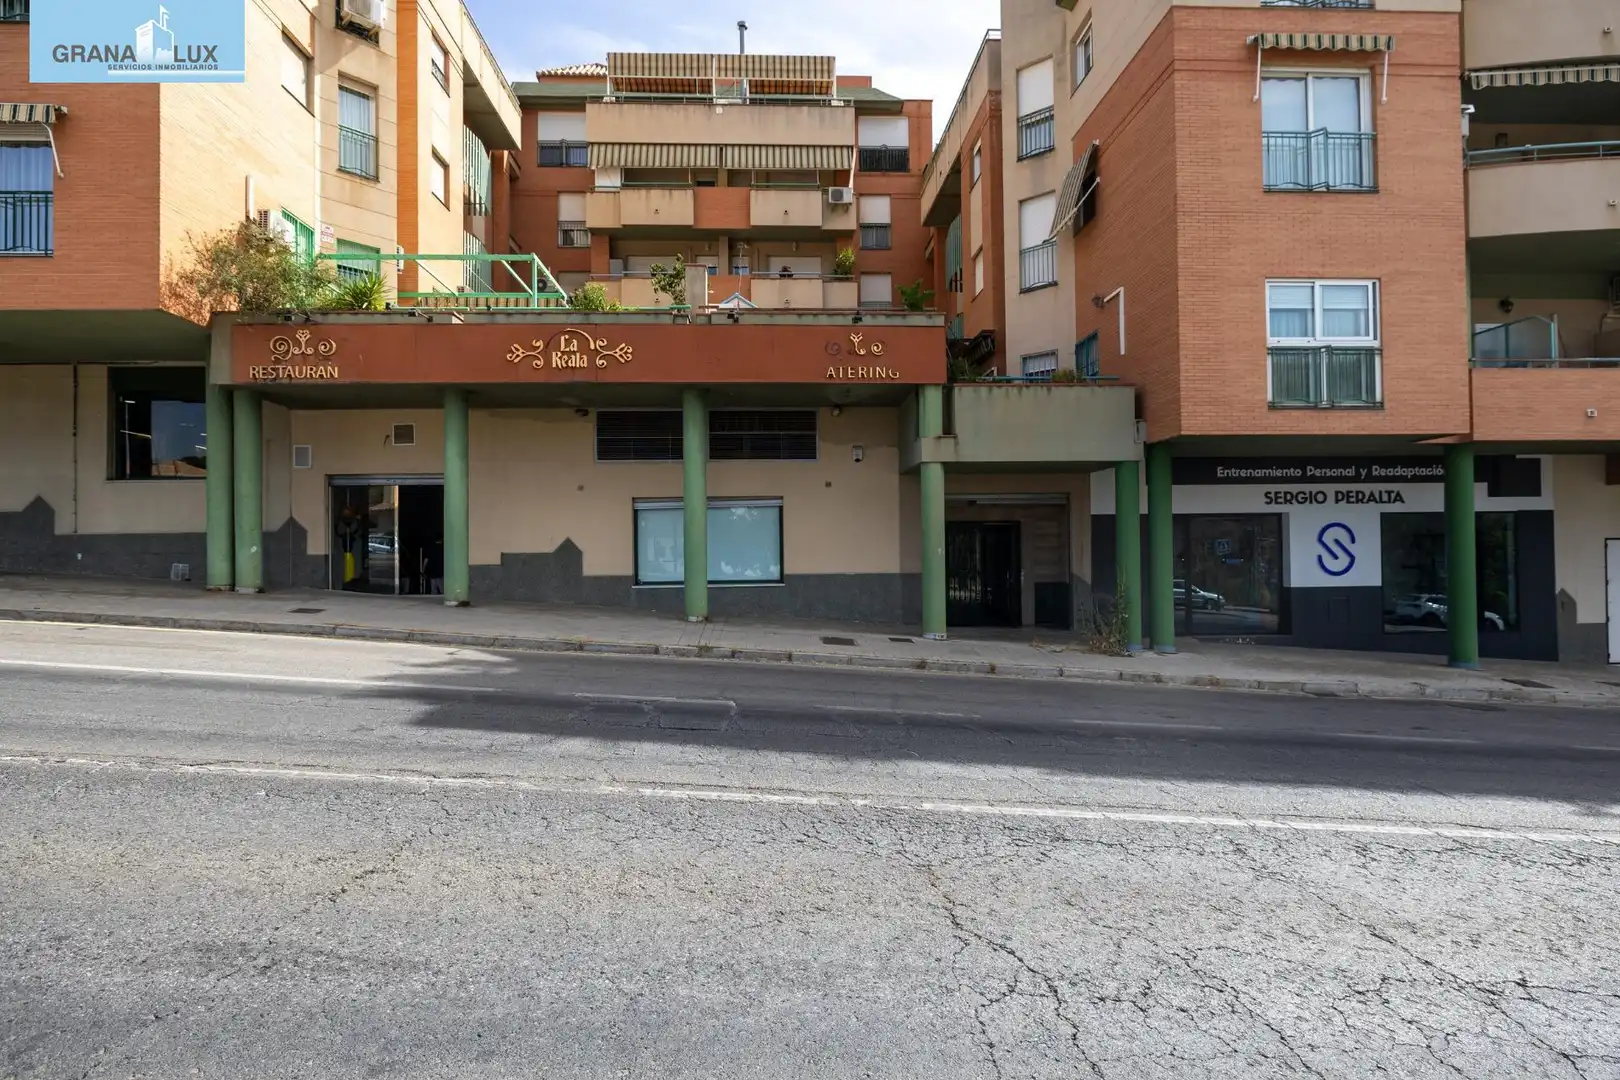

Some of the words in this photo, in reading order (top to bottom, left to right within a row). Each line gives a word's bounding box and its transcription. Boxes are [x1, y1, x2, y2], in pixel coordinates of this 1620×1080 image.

[560, 335, 578, 352] La
[552, 352, 588, 369] Reala
[1217, 467, 1302, 476] Entrenamiento
[1306, 466, 1355, 476] Personal
[1360, 468, 1367, 479] y
[1372, 465, 1445, 479] Readaptació
[1264, 491, 1328, 504] SERGIO
[1334, 490, 1405, 504] PERALTA
